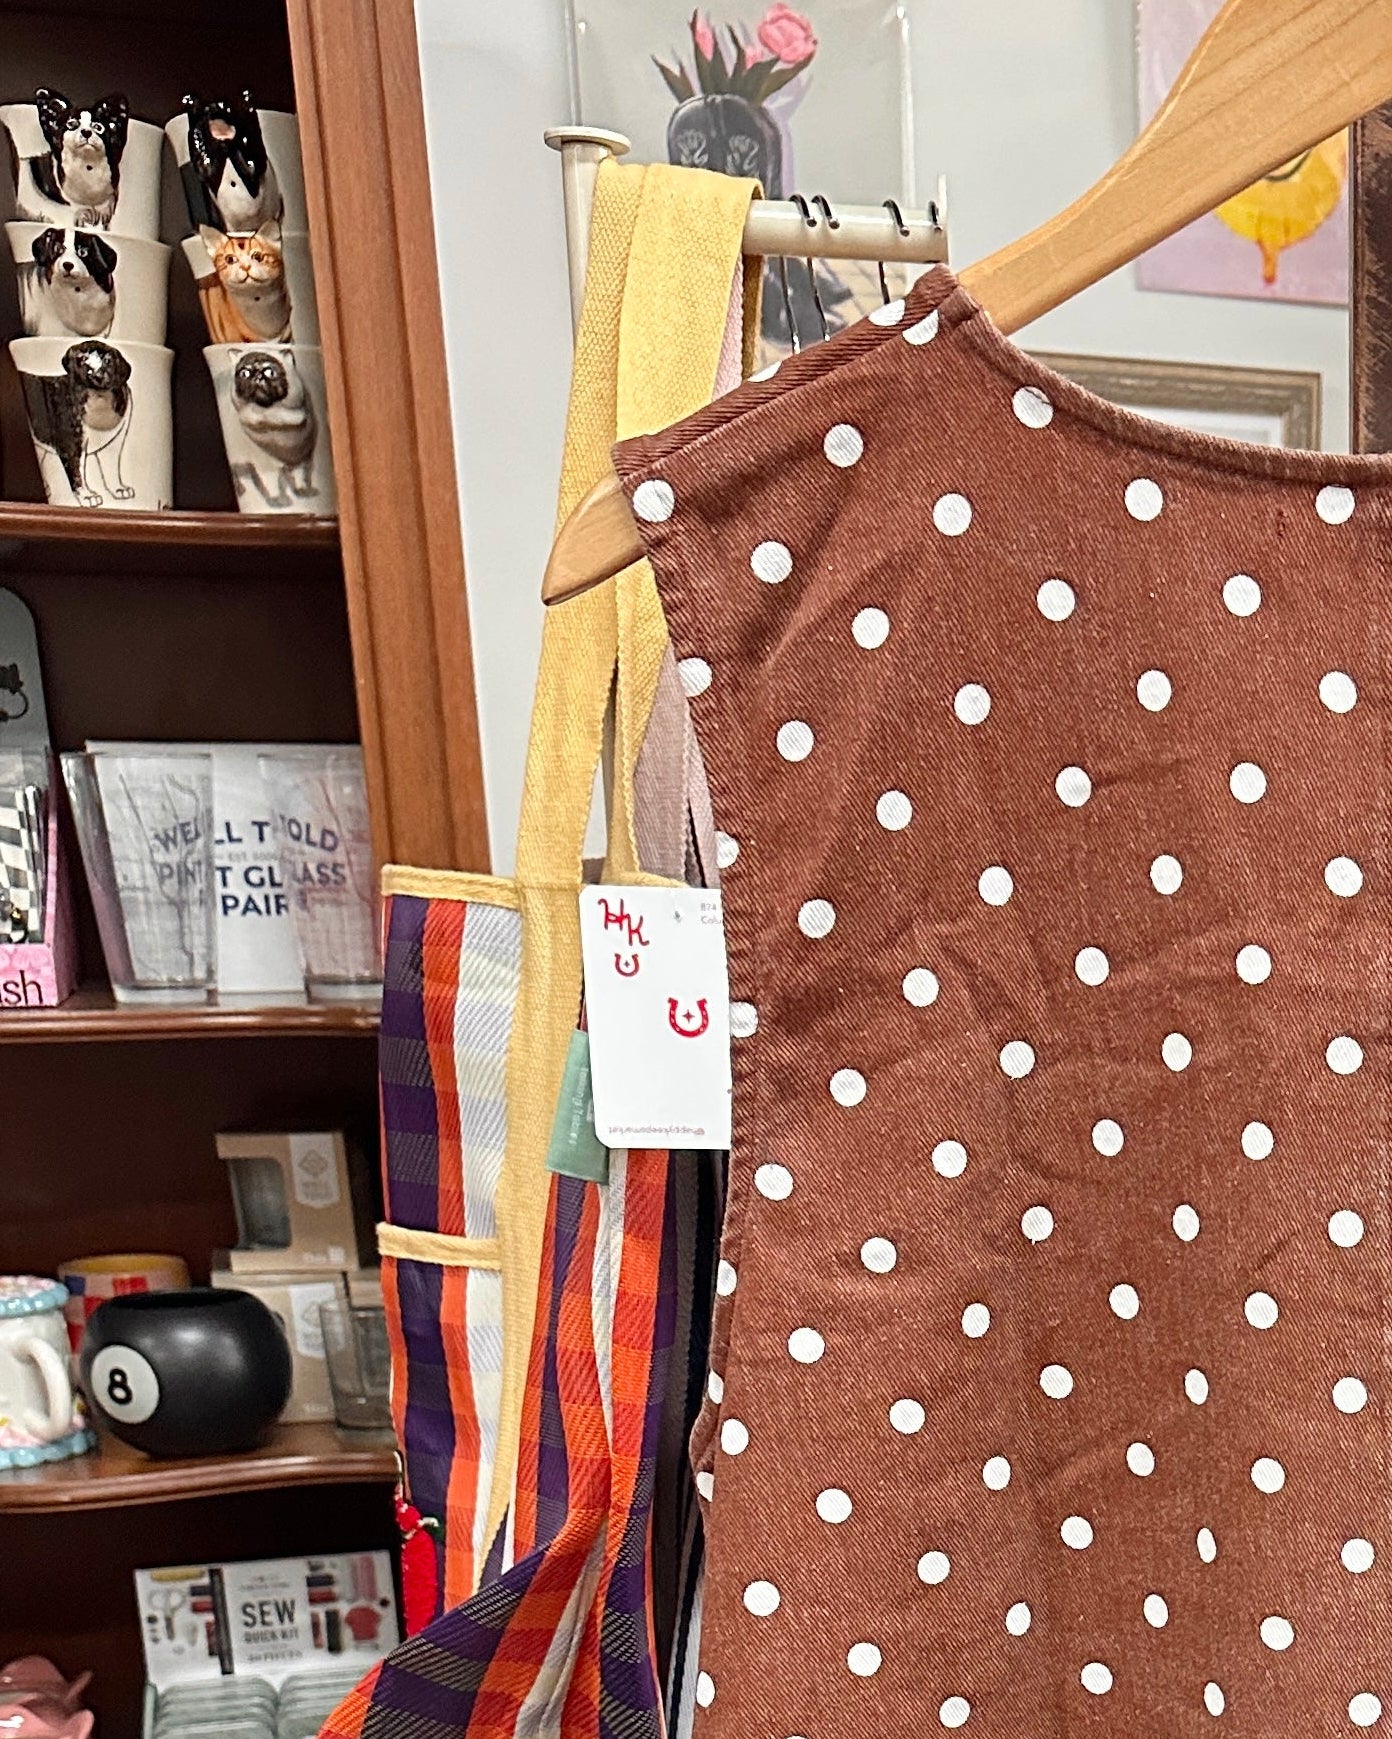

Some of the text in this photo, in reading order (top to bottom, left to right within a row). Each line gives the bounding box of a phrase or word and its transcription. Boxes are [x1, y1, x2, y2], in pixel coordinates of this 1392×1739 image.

[0, 969, 43, 1005] sh
[108, 1368, 133, 1405] 8
[241, 1598, 296, 1628] SEW
